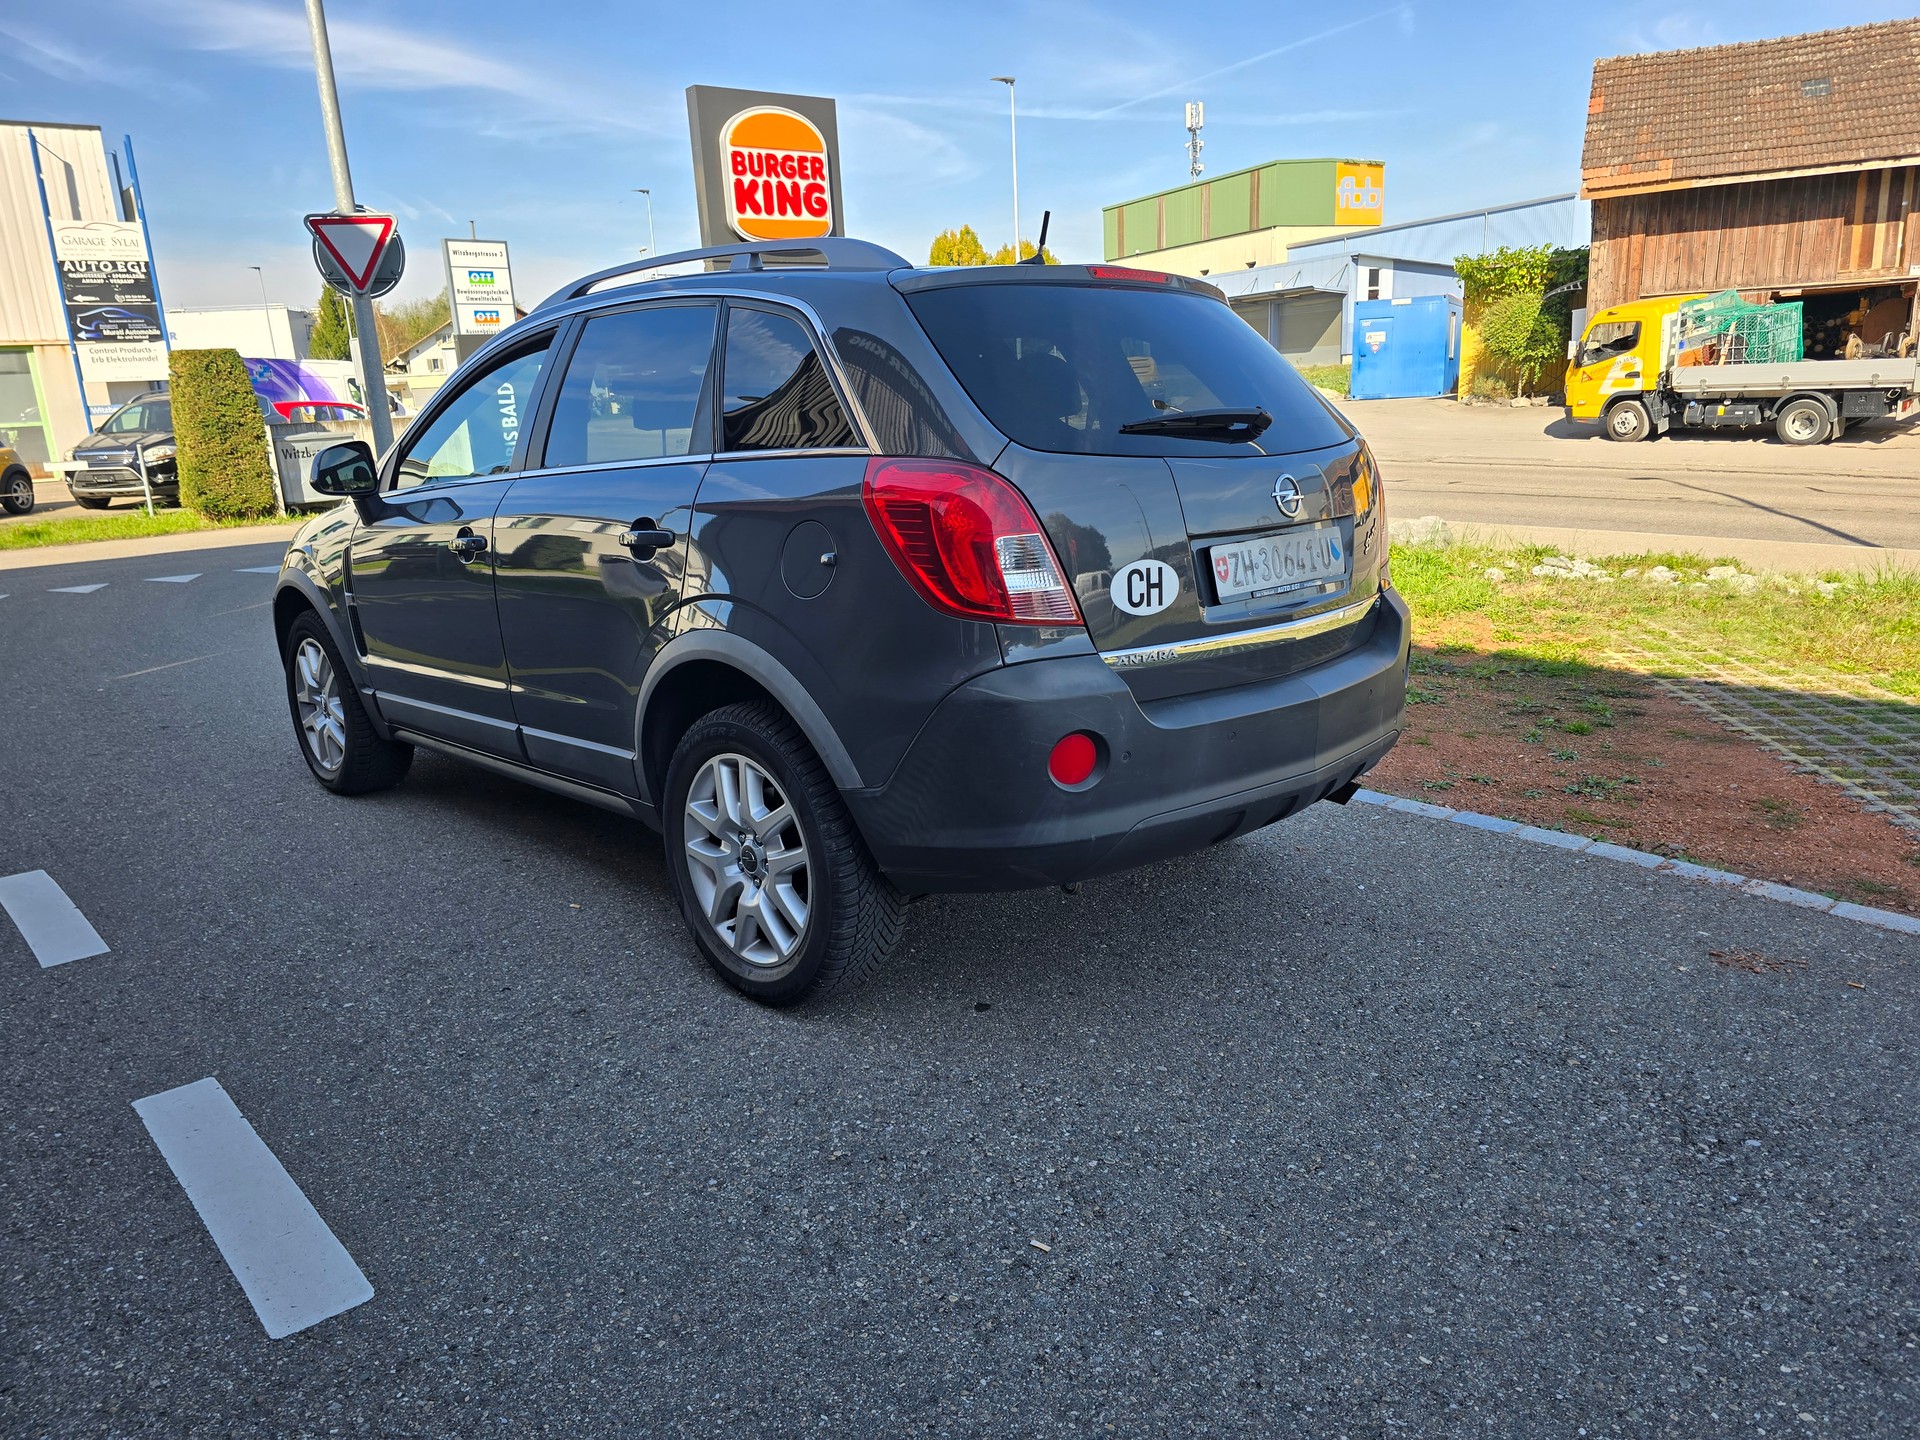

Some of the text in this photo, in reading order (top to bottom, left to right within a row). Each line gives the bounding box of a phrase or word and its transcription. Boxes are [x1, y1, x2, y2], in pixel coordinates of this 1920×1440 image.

[731, 151, 825, 182] BURGER
[734, 178, 828, 218] KING
[61, 235, 106, 246] GARAGE
[452, 249, 498, 258] Witzbergstrasse
[63, 260, 147, 274] AUTO EGI
[471, 272, 492, 282] OTT
[476, 312, 498, 321] OTT
[125, 328, 161, 336] Automobile
[89, 347, 118, 355] Control
[119, 346, 152, 354] Products
[91, 355, 159, 364] Erb Elektrohandel
[497, 382, 518, 428] BALD
[281, 446, 320, 459] Witzb
[1127, 566, 1163, 609] CH
[1277, 584, 1291, 593] AUTO
[1117, 649, 1178, 667] ANTARA
[728, 728, 737, 737] 2
